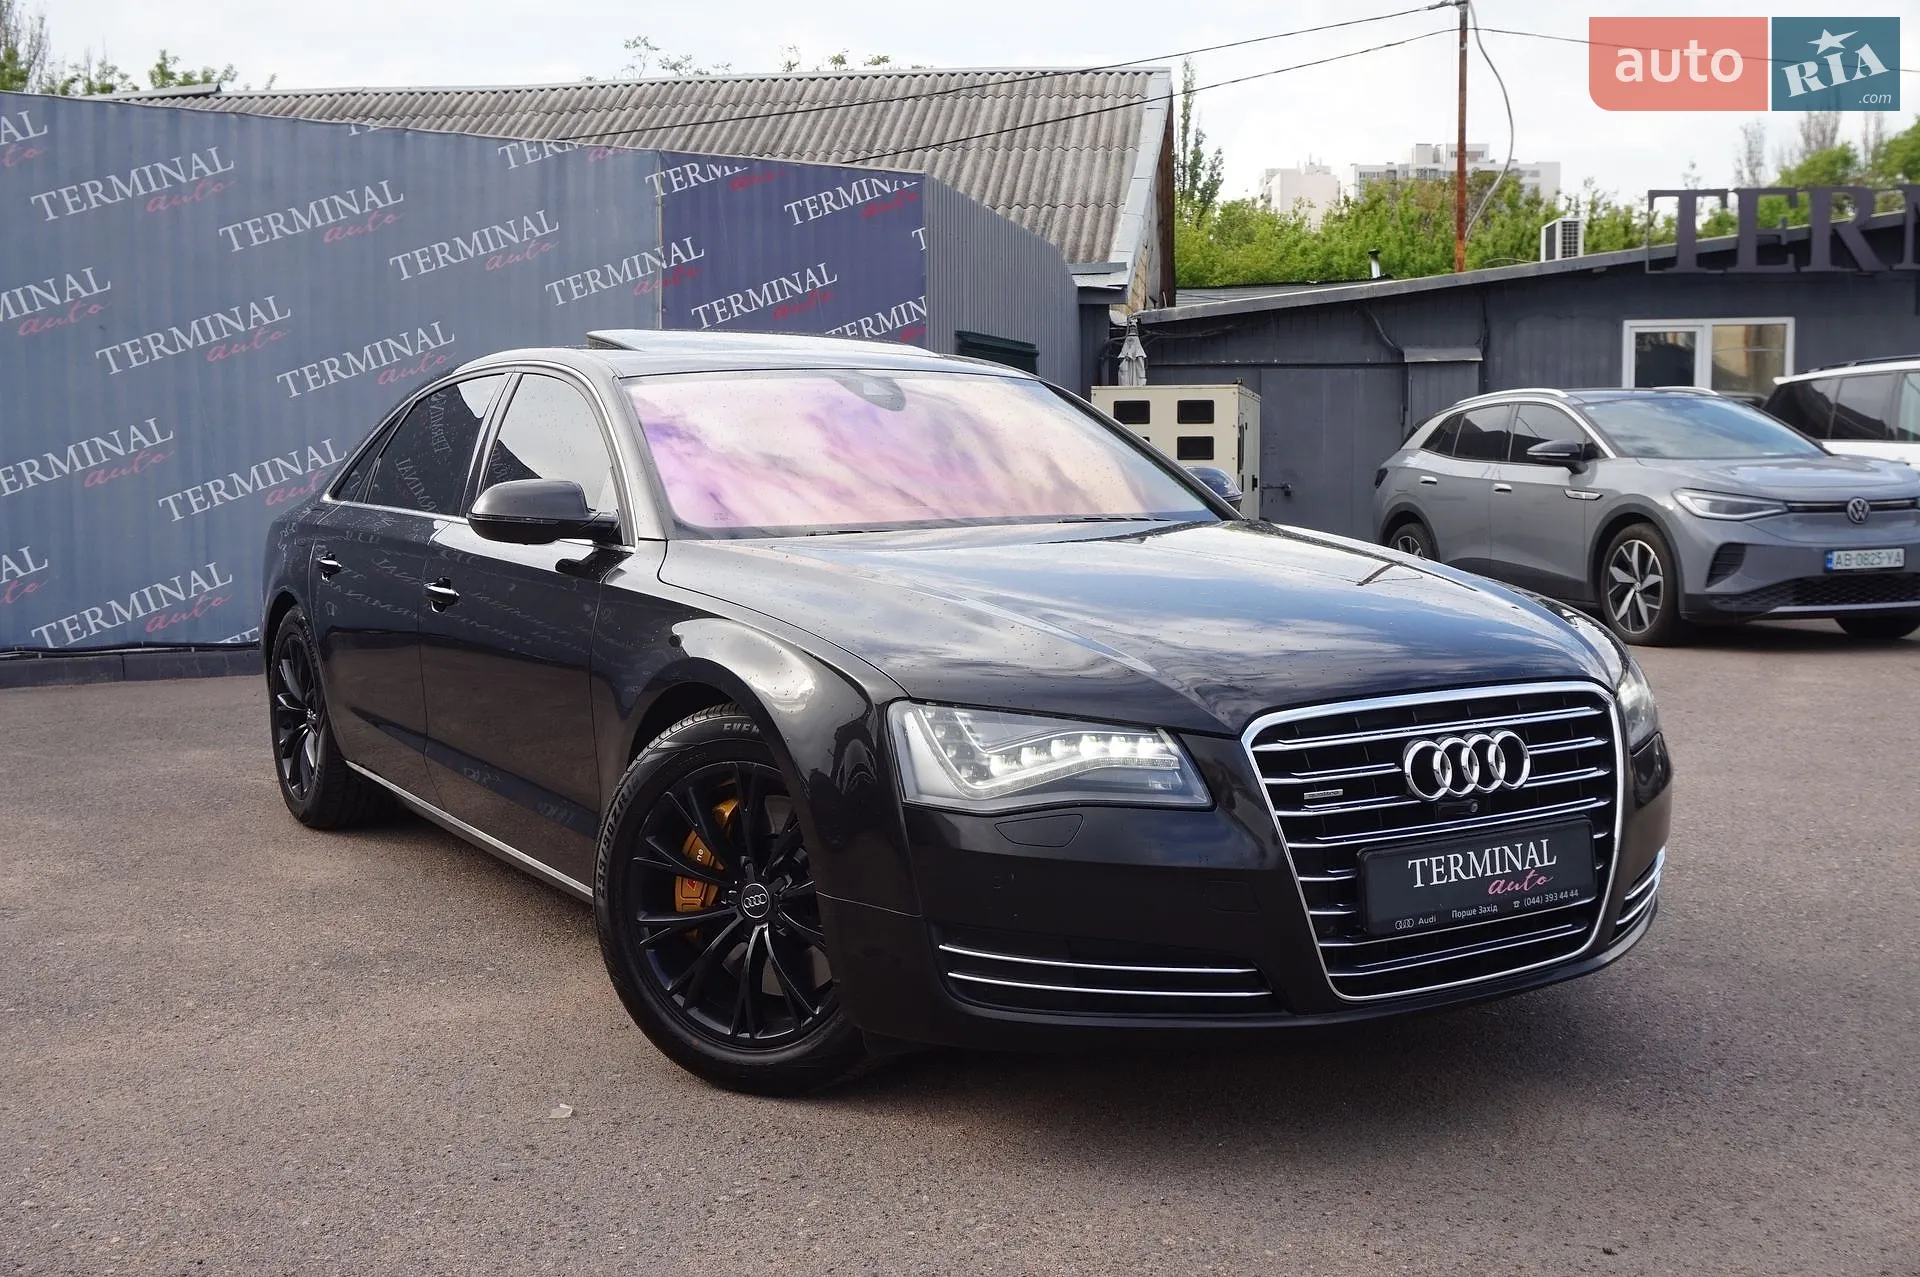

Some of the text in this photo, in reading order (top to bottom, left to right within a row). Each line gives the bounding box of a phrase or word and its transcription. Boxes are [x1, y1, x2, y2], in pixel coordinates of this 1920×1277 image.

[31, 147, 235, 222] TERMINAL
[146, 180, 236, 213] auto
[218, 179, 404, 253] TERMINAL
[323, 210, 404, 243] auto
[389, 209, 560, 282] TERMINAL
[485, 238, 559, 272] auto
[544, 236, 705, 306] TERMINAL
[691, 262, 838, 330] TERMINAL
[18, 300, 108, 336] auto
[95, 295, 292, 375] TERMINAL
[206, 326, 291, 362] auto
[276, 321, 455, 399] TERMINAL
[376, 352, 455, 385] auto
[84, 450, 175, 488] auto
[158, 438, 348, 522] TERMINAL
[265, 469, 327, 507] aut
[31, 561, 233, 649] TERMINAL
[144, 593, 233, 633] auto
[1408, 839, 1557, 888] TERMINAL
[1488, 868, 1554, 895] auto
[1451, 908, 1477, 919] Порше
[1524, 888, 1579, 907] (044) 393 44 44
[1418, 915, 1437, 925] Audi
